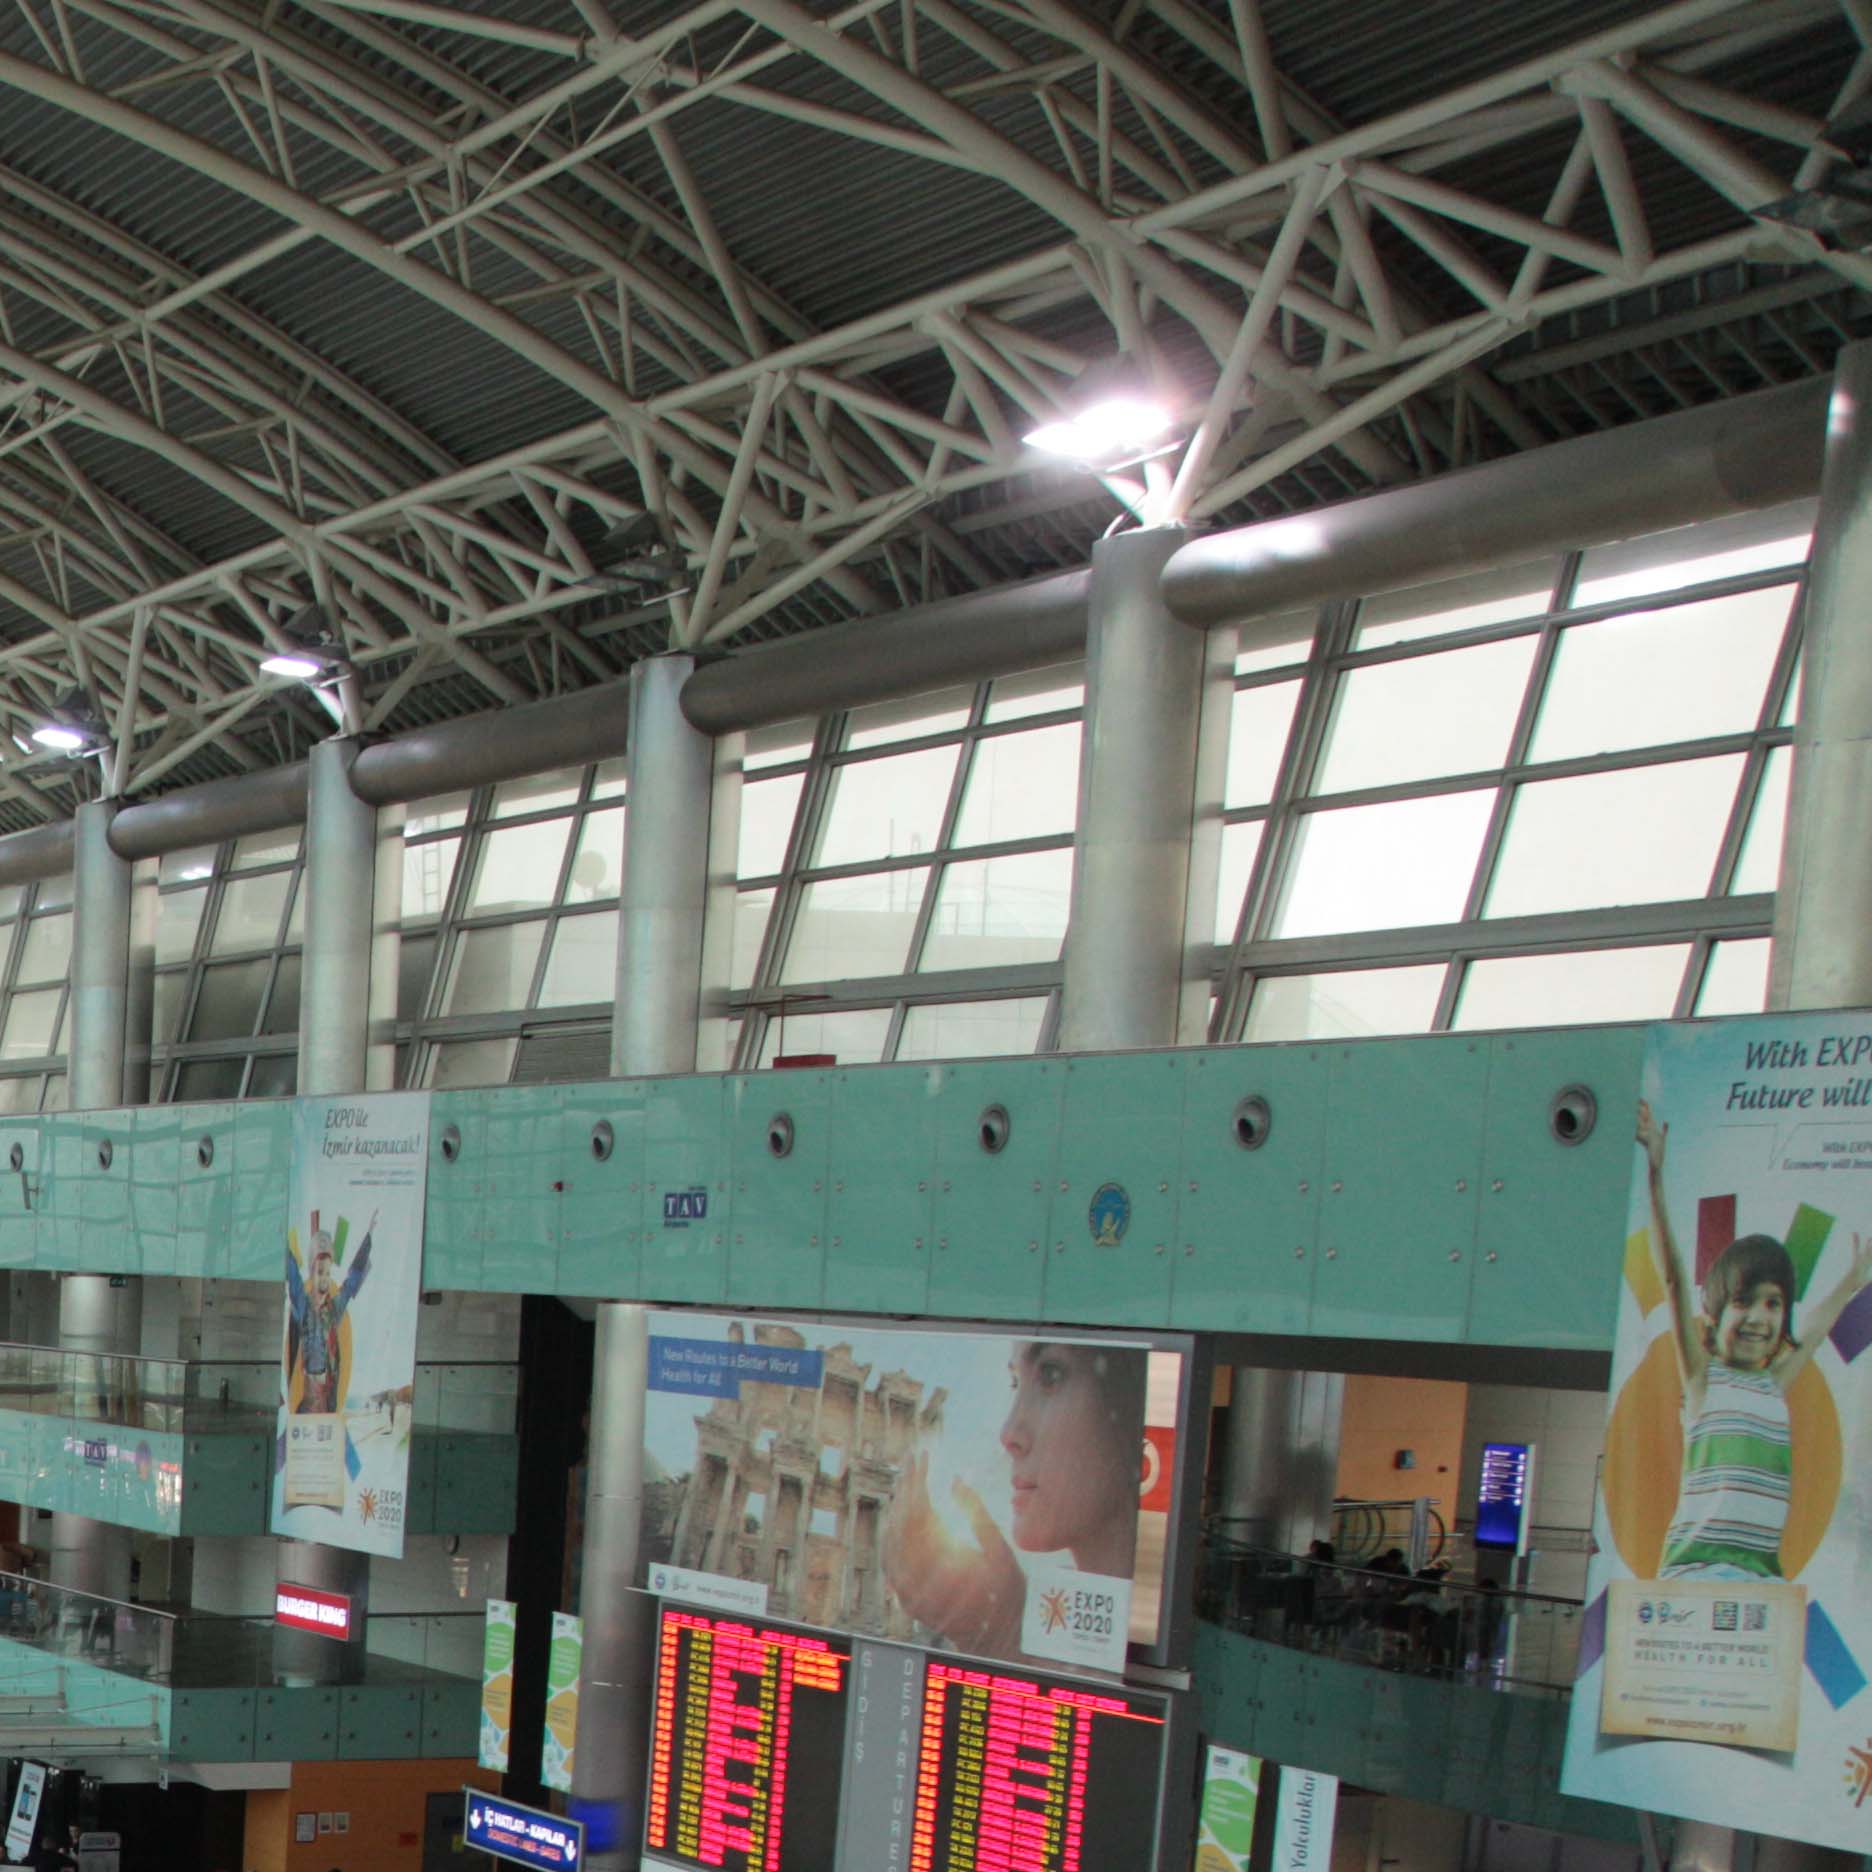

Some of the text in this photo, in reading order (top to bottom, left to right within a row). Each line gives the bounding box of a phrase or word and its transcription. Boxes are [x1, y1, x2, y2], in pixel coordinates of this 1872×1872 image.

[1745, 1036, 1872, 1071] With EXP
[1726, 1080, 1813, 1111] Future
[325, 1107, 356, 1130] EXPO
[666, 1195, 706, 1217] TAV
[737, 1353, 768, 1371] Better
[769, 1356, 799, 1373] World
[378, 1488, 402, 1506] EXPO
[378, 1505, 402, 1523] 2020
[277, 1594, 347, 1628] BURGER KING
[1075, 1591, 1113, 1613] EXPO
[1074, 1612, 1112, 1635] 2020
[1634, 1650, 1769, 1668] HEALTH FOR ALL
[1292, 1773, 1317, 1868] Yolculuklar
